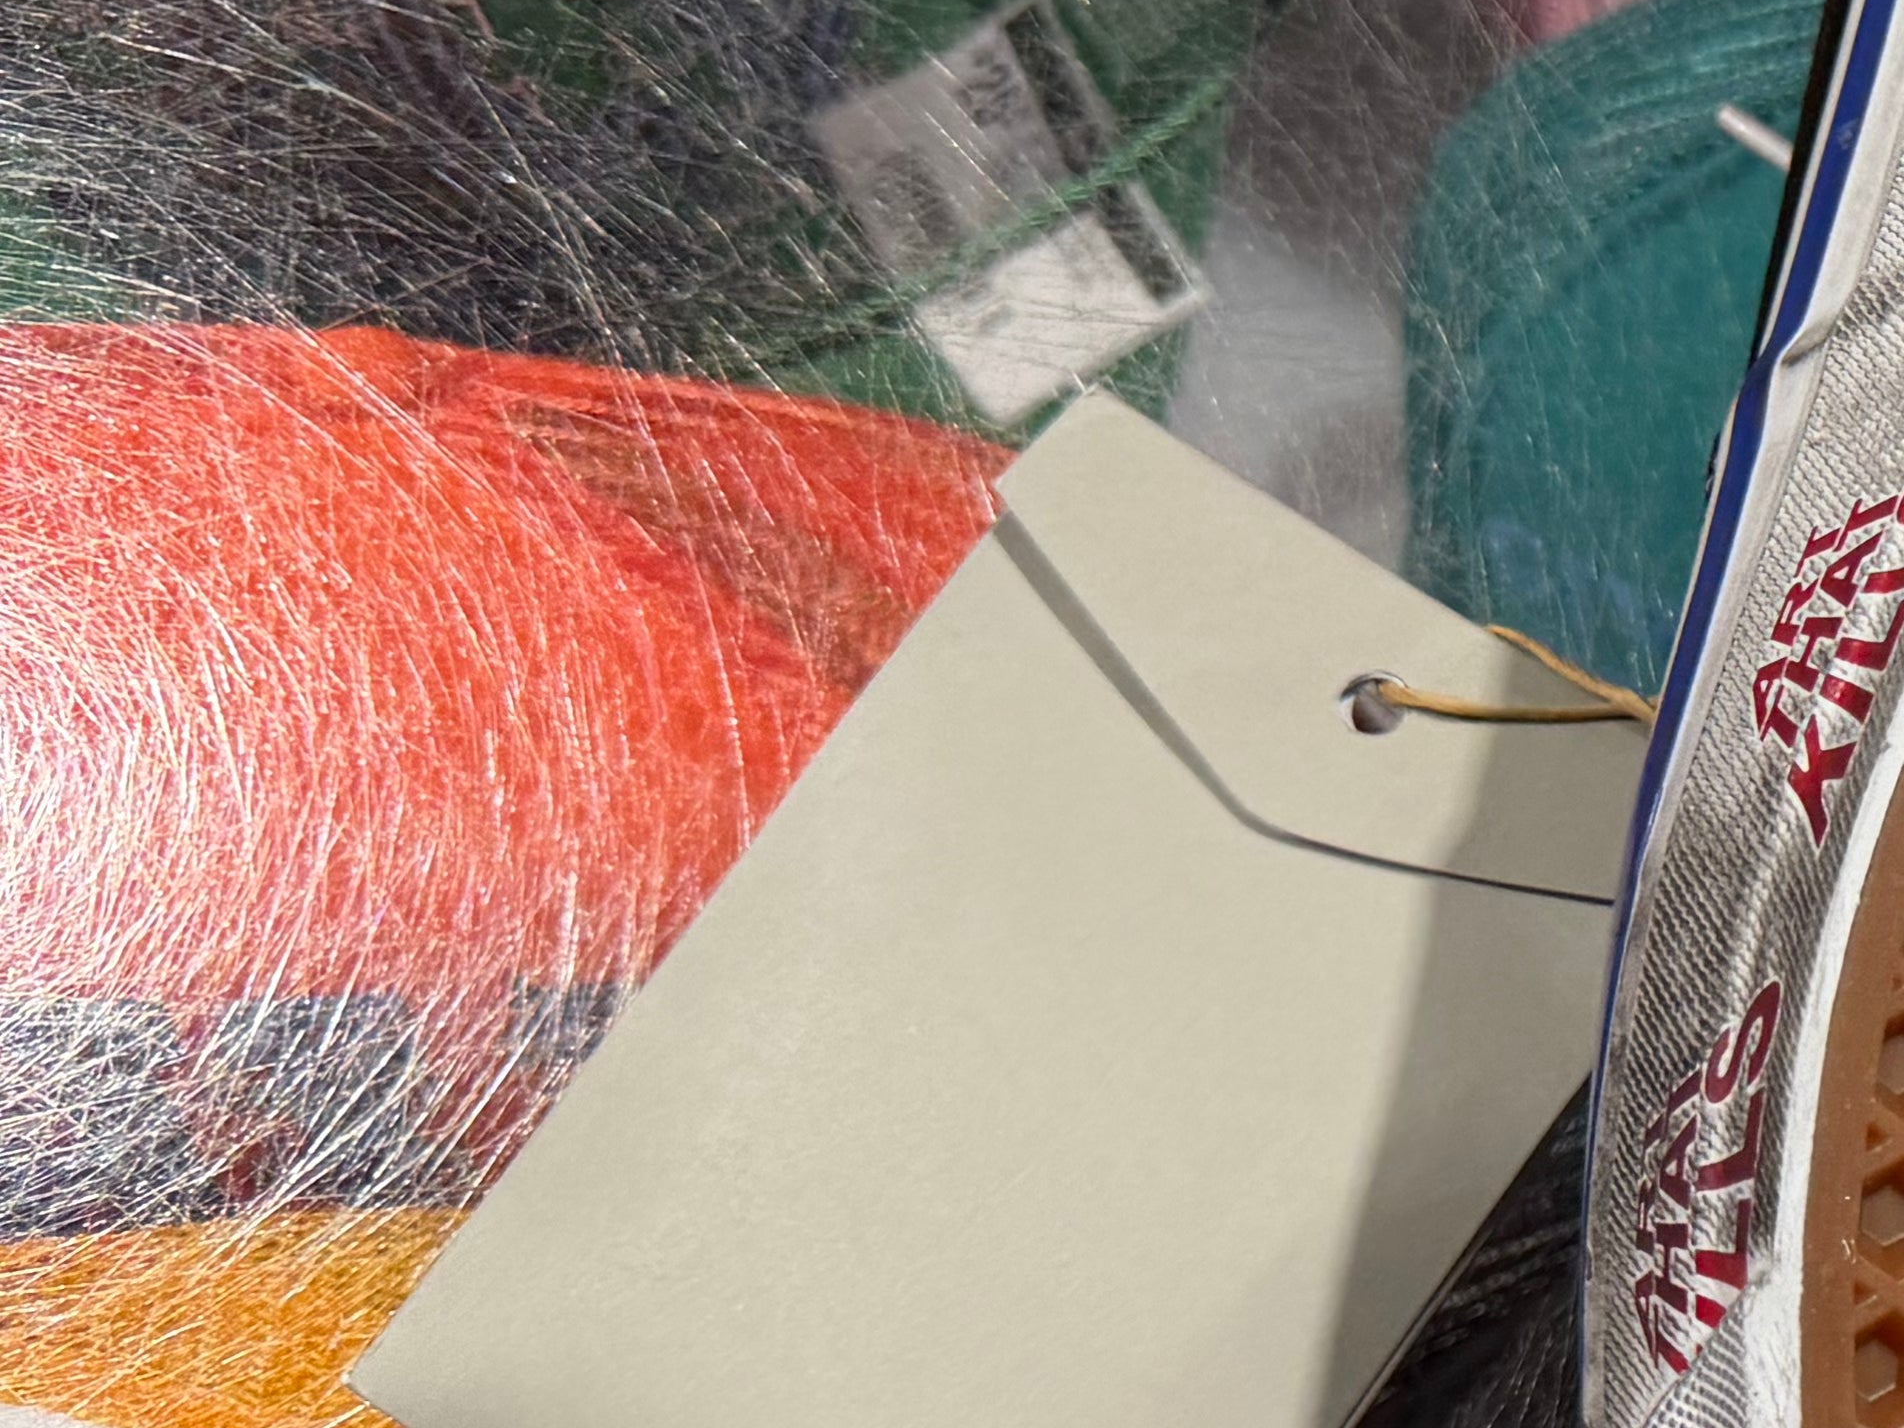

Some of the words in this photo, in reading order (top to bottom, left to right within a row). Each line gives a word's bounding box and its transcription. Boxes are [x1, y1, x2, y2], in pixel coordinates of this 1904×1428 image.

[1752, 525, 1841, 742] ART
[1760, 494, 1900, 749] THAT
[1693, 979, 1782, 1357] ILLS
